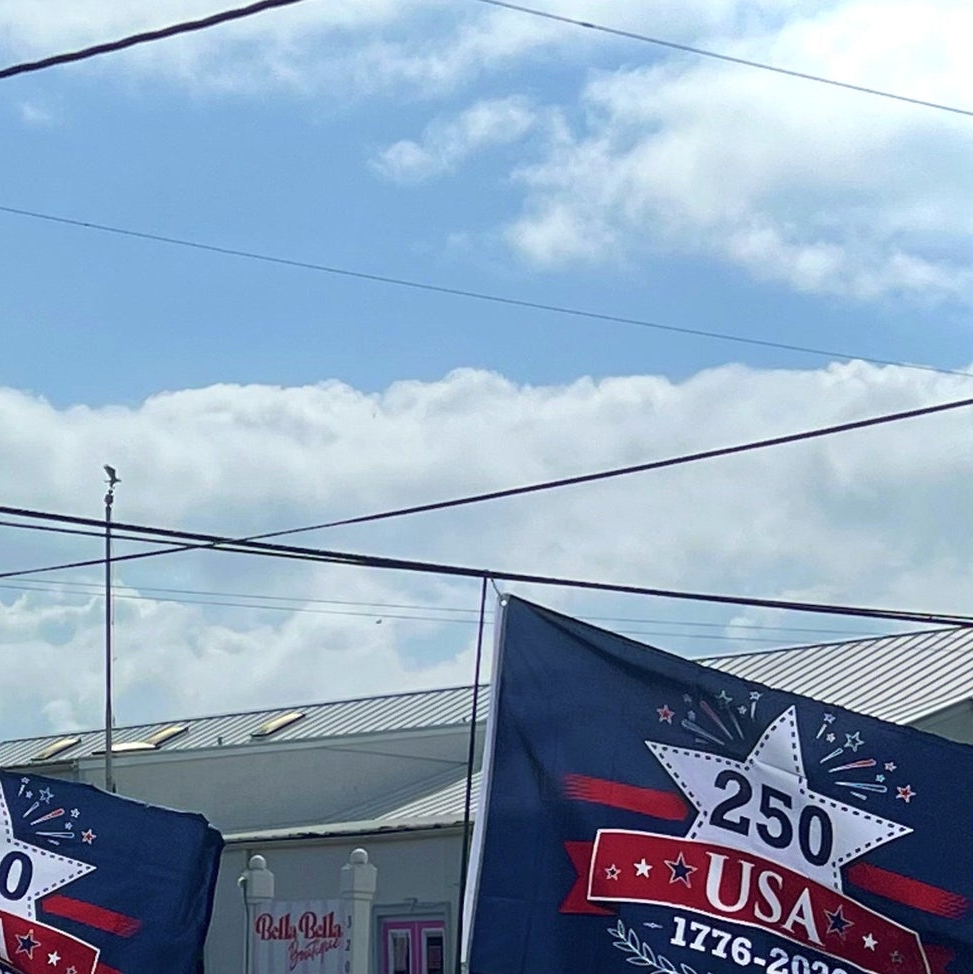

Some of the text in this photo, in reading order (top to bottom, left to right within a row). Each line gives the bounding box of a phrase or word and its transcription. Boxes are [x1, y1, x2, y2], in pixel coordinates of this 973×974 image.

[708, 769, 834, 867] 250
[255, 911, 343, 940] Bella Bella
[704, 850, 825, 948] USA
